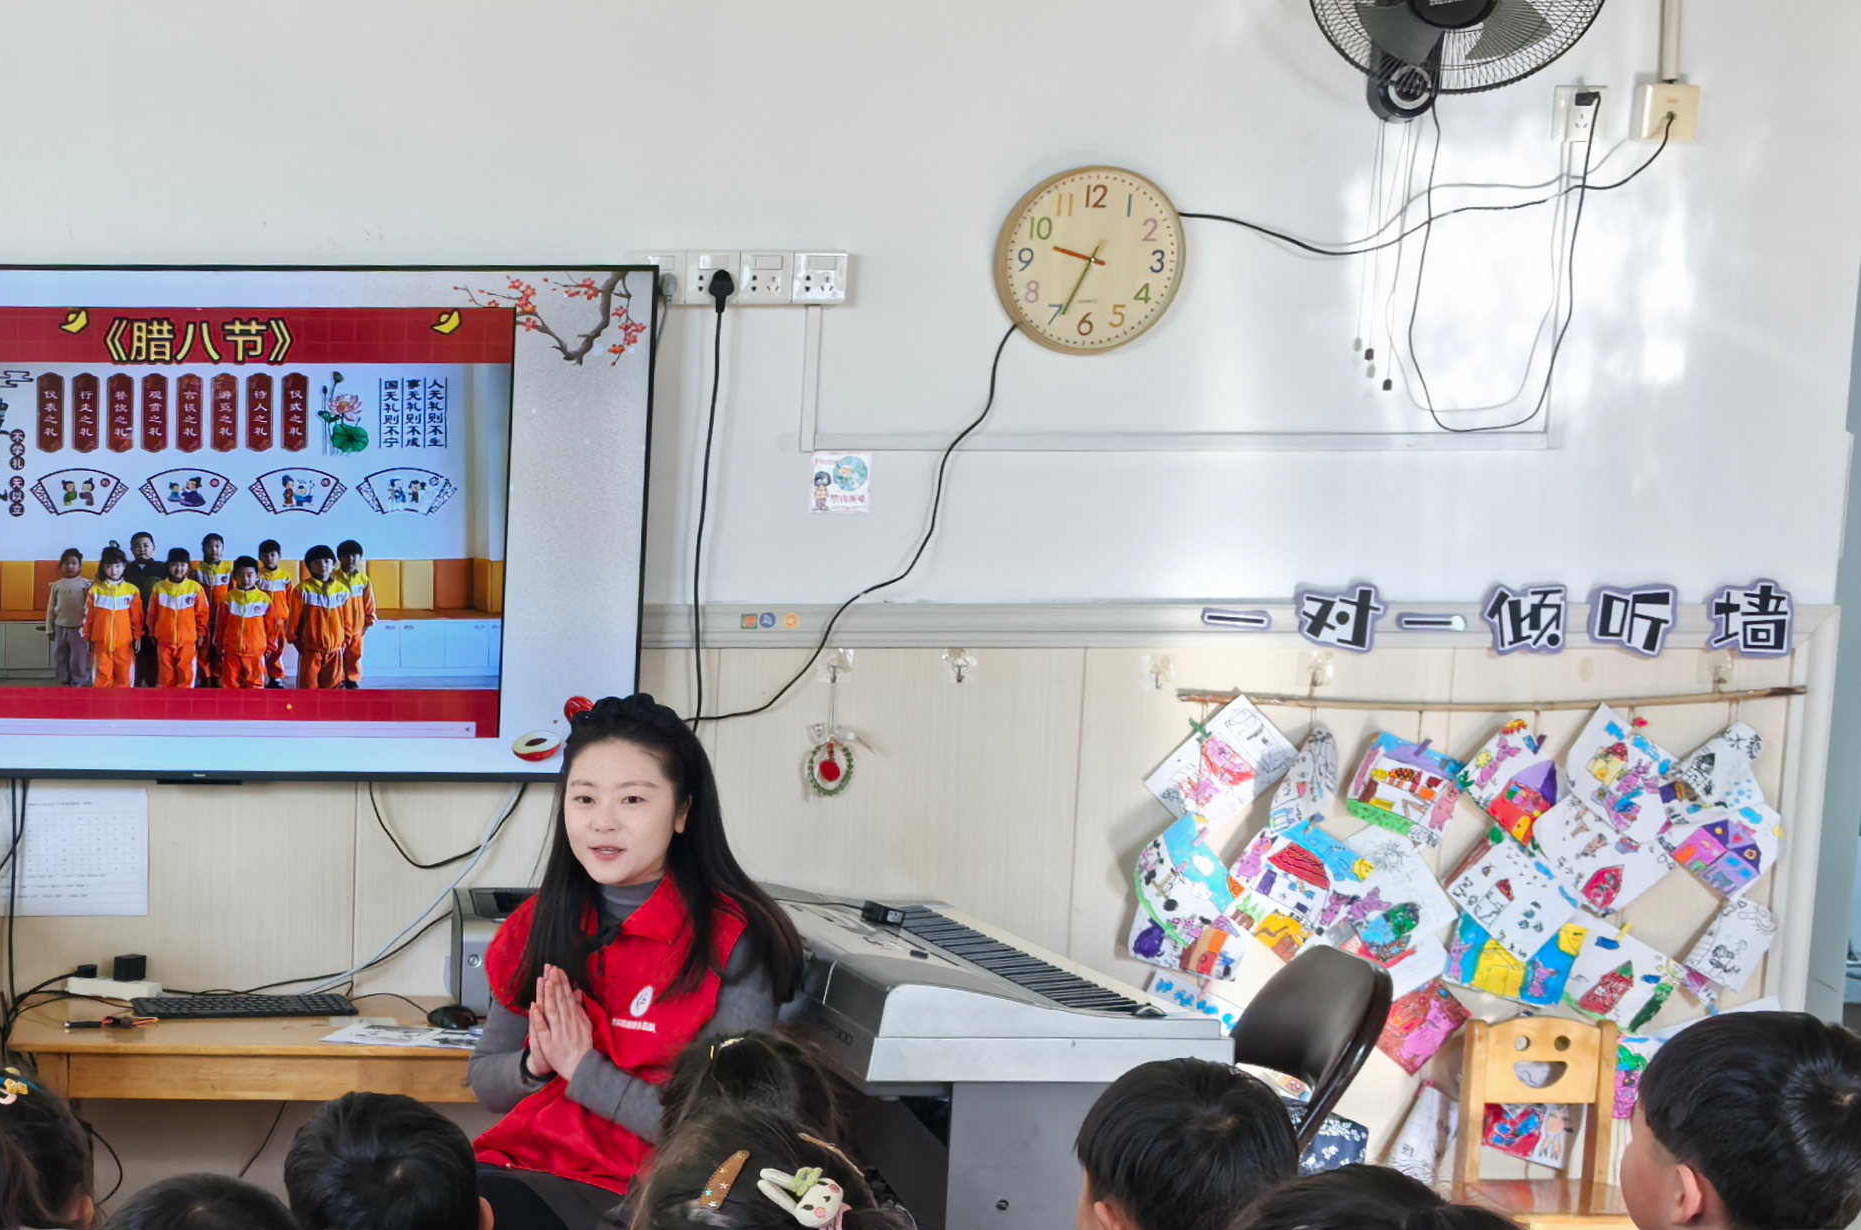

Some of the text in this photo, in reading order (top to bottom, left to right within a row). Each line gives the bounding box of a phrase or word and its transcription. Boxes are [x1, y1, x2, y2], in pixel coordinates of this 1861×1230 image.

[1056, 193, 1073, 217] 11
[1085, 184, 1108, 208] 12
[1127, 194, 1133, 217] 1
[1030, 216, 1053, 240] 10
[1141, 218, 1158, 242] 2
[1018, 247, 1034, 272] 9
[1150, 249, 1165, 273] 3
[1024, 280, 1040, 303] 8
[1133, 282, 1151, 304] 4
[1048, 303, 1063, 325] 7
[1076, 312, 1093, 336] 6
[1108, 304, 1126, 328] 5
[105, 318, 293, 364] 《腊八节》
